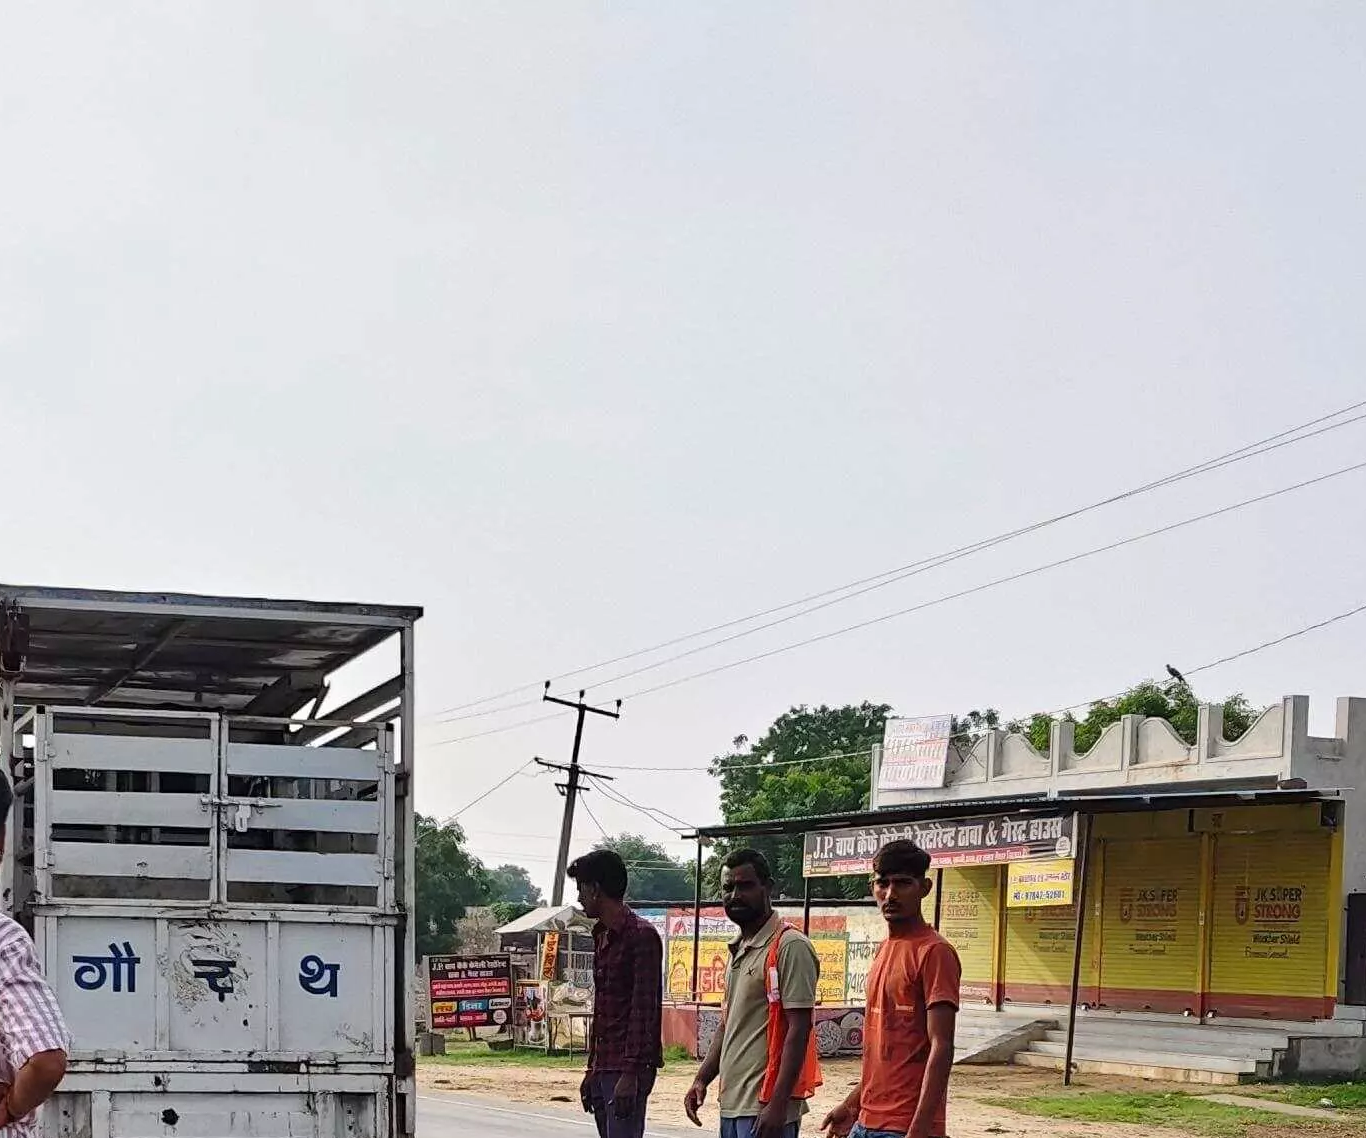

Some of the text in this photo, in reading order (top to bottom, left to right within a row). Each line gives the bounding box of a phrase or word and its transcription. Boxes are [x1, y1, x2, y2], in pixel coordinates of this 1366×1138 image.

[957, 825, 984, 847] ढाबा
[986, 820, 999, 846] &
[1001, 816, 1027, 843] गेस्ट
[1254, 887, 1268, 902] JK
[1254, 903, 1301, 919] STRONG
